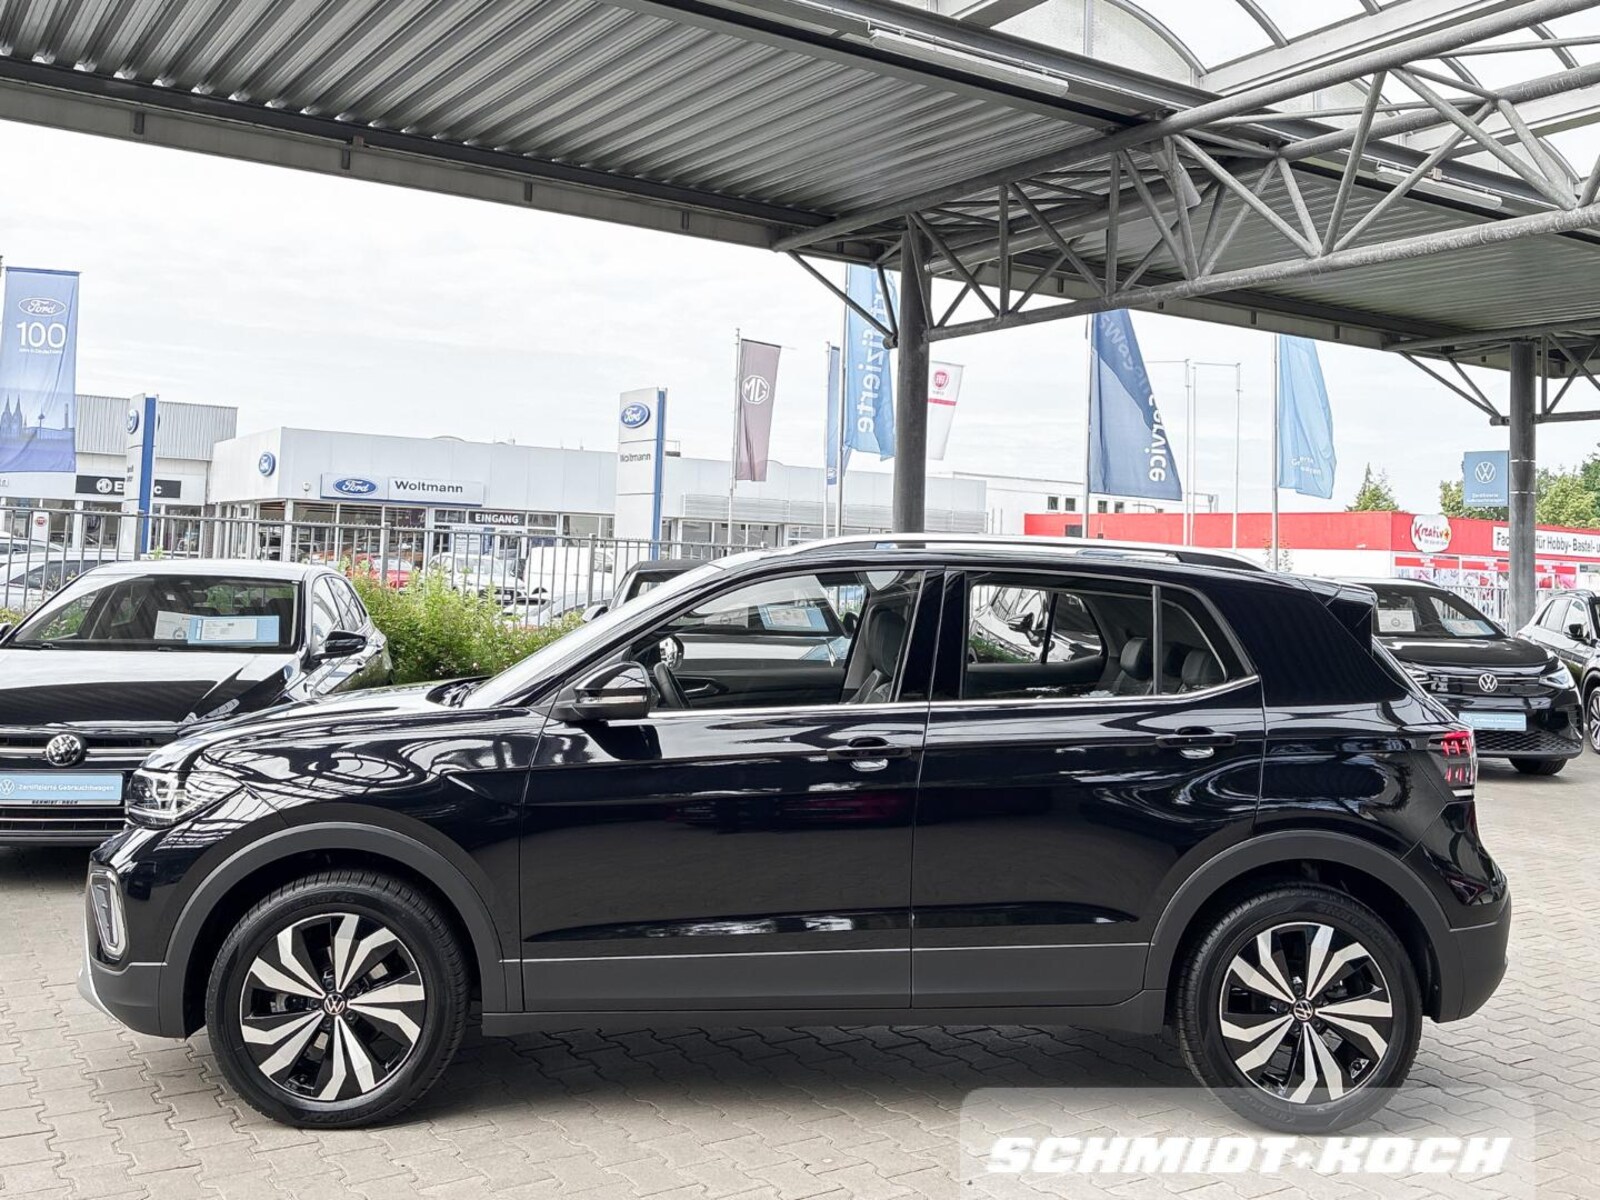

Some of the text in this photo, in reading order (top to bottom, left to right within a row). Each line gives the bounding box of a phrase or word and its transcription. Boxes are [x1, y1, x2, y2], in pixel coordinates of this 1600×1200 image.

[16, 321, 67, 348] 100
[743, 377, 768, 402] MG
[394, 480, 464, 493] Woltmann
[474, 512, 520, 524] EINGANG
[1547, 536, 1572, 553] Hobby-
[1572, 538, 1596, 552] Bastel-
